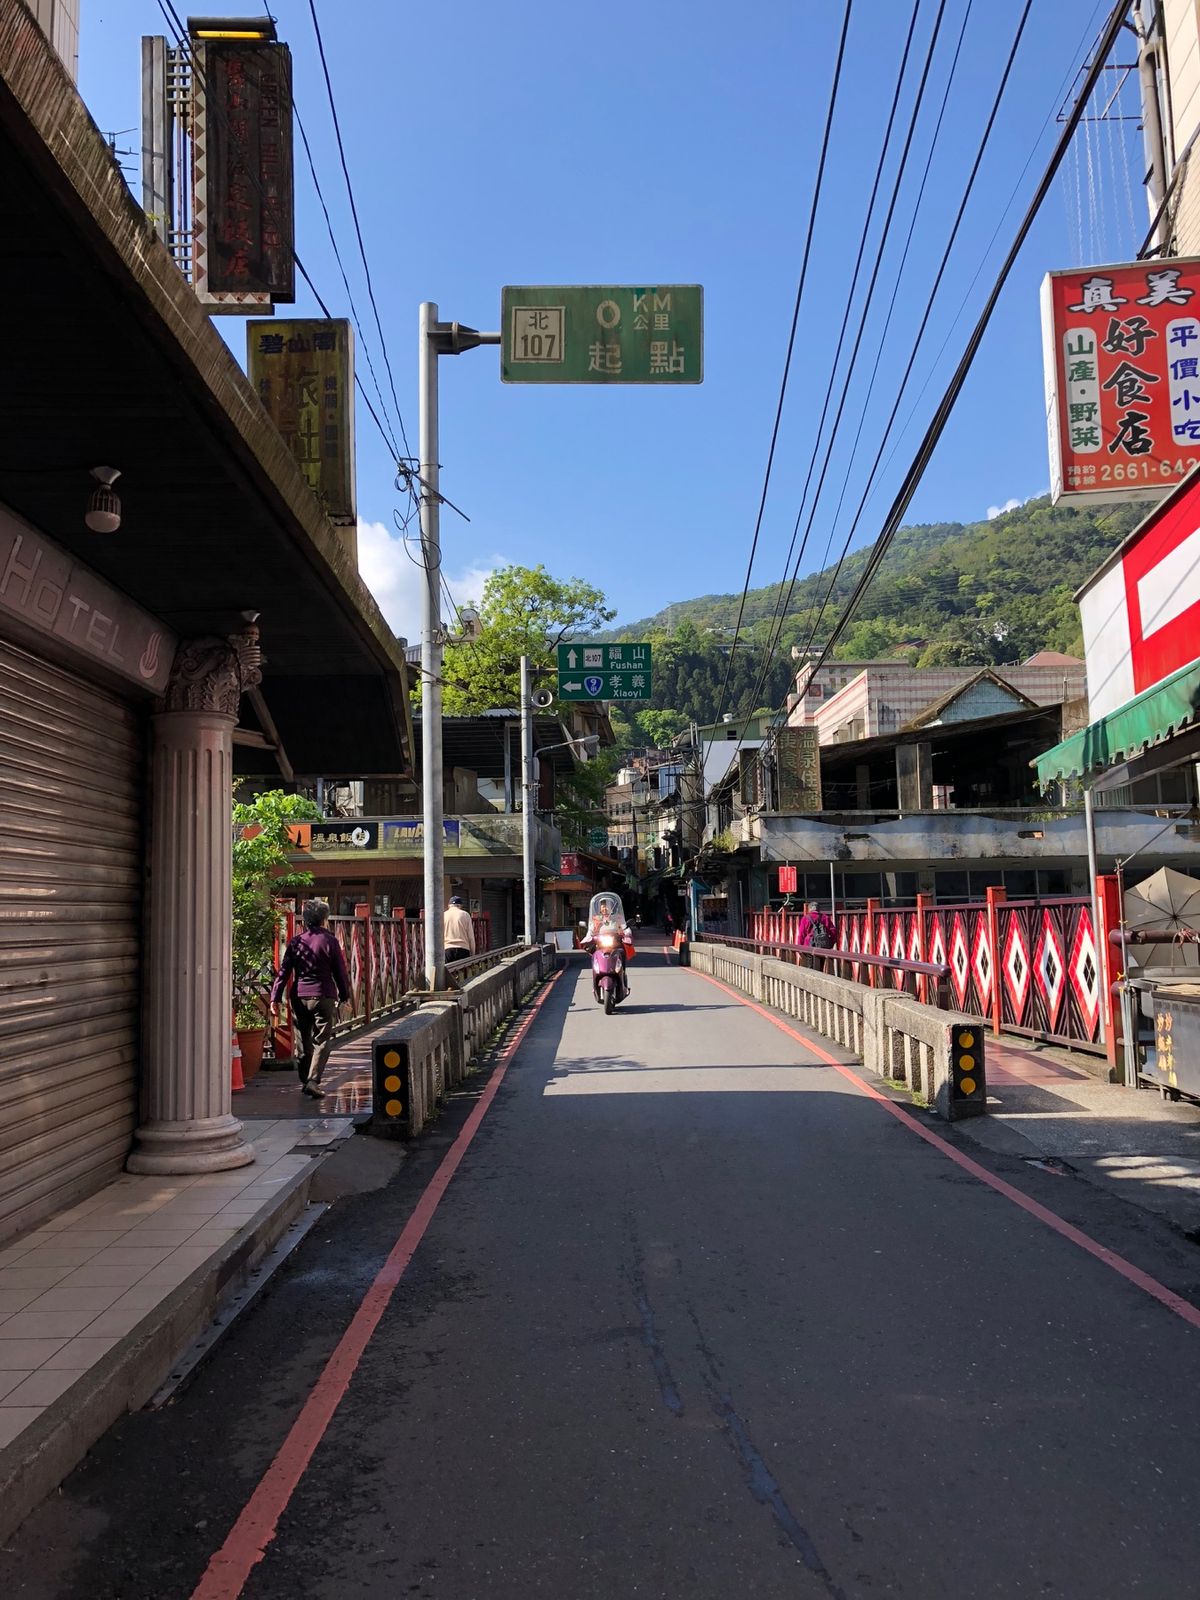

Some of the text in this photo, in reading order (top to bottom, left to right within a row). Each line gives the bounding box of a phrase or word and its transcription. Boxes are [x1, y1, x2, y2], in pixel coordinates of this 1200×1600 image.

[1067, 269, 1195, 313] 真美
[633, 294, 671, 312] KM
[528, 311, 548, 330] 北
[633, 314, 671, 331] 公里
[521, 334, 556, 357] 107
[588, 340, 685, 374] 起點
[1102, 316, 1160, 456] 好食店
[1170, 325, 1200, 440] 平價小吃
[609, 646, 645, 660] 福山
[610, 661, 643, 670] Fushan
[609, 674, 645, 689] 孝義
[613, 689, 642, 698] Xiaoyi
